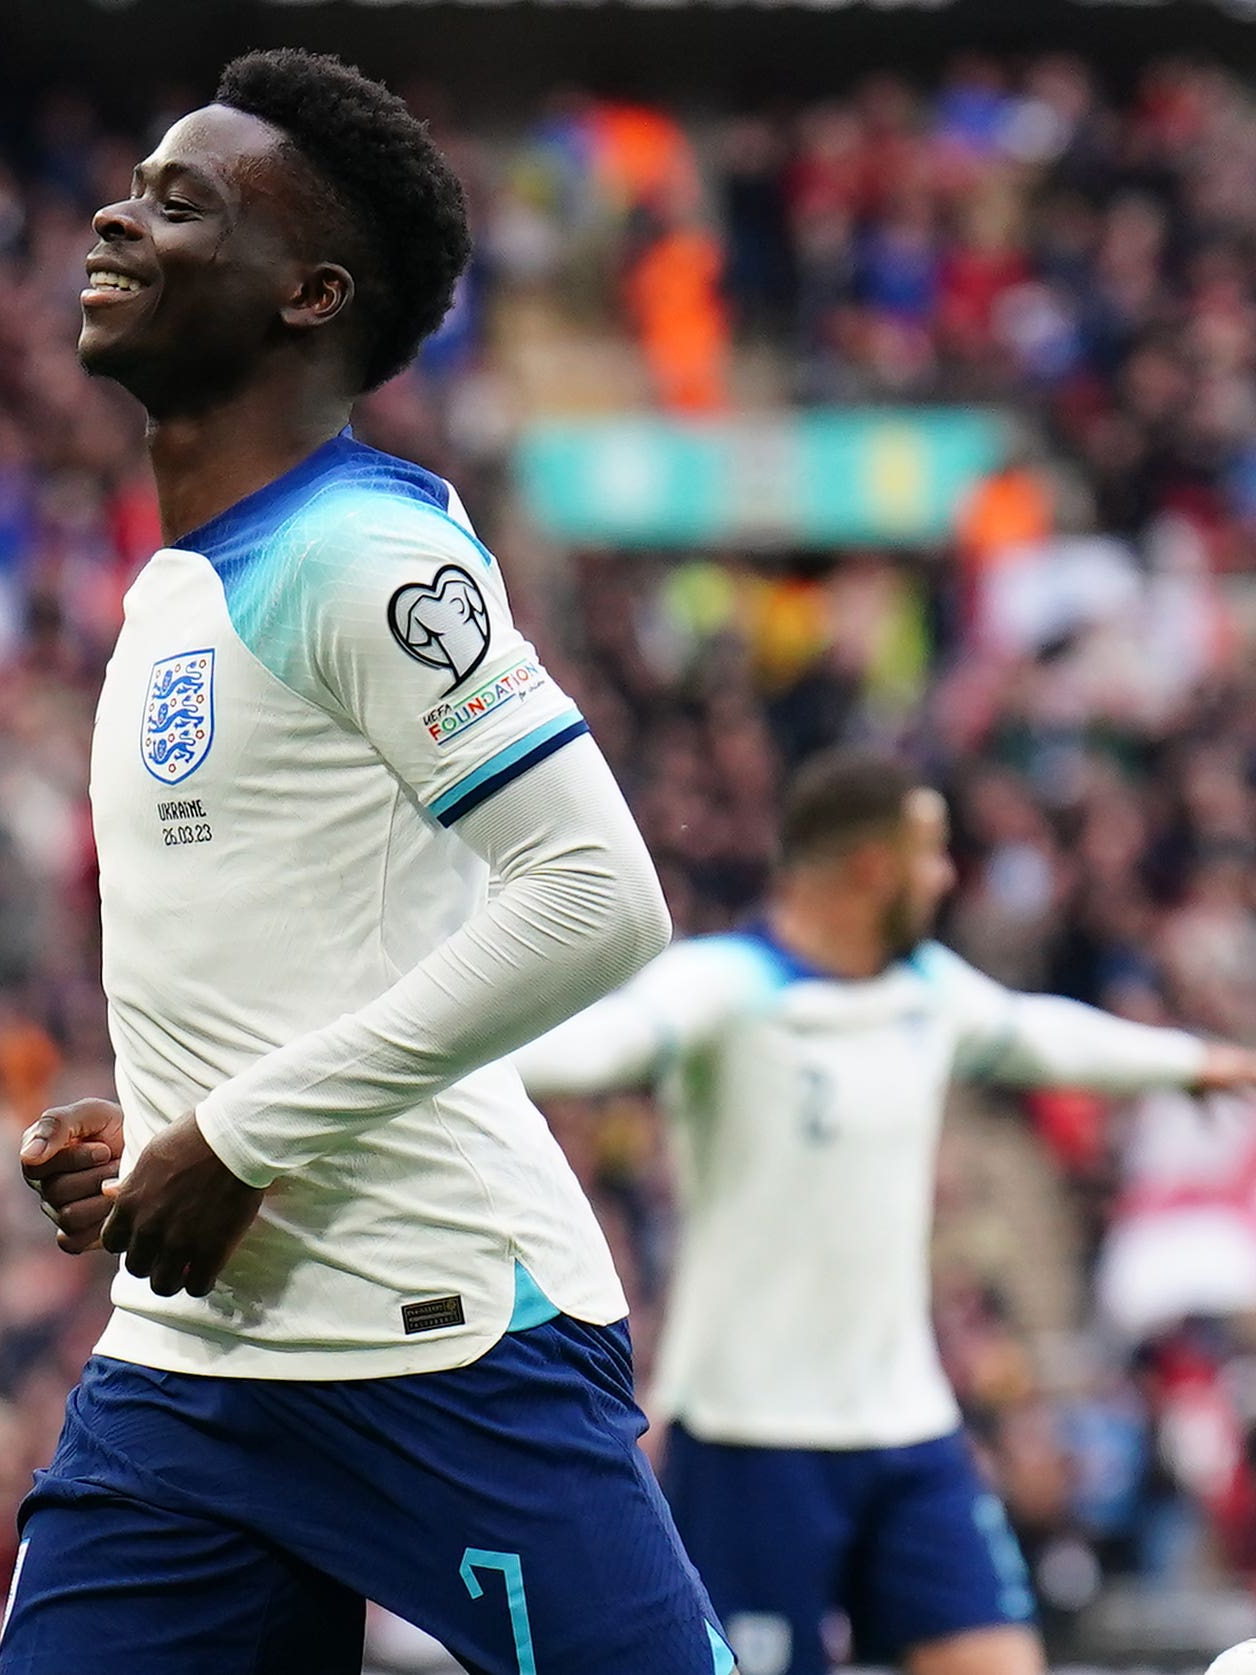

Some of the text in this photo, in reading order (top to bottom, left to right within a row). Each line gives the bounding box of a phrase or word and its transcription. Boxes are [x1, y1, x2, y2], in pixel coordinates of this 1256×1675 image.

[428, 664, 538, 741] FOUNDATION
[422, 703, 452, 725] UEFA
[158, 799, 206, 821] UKRAINE
[162, 824, 212, 846] 26.03.23
[459, 1547, 537, 1675] 7
